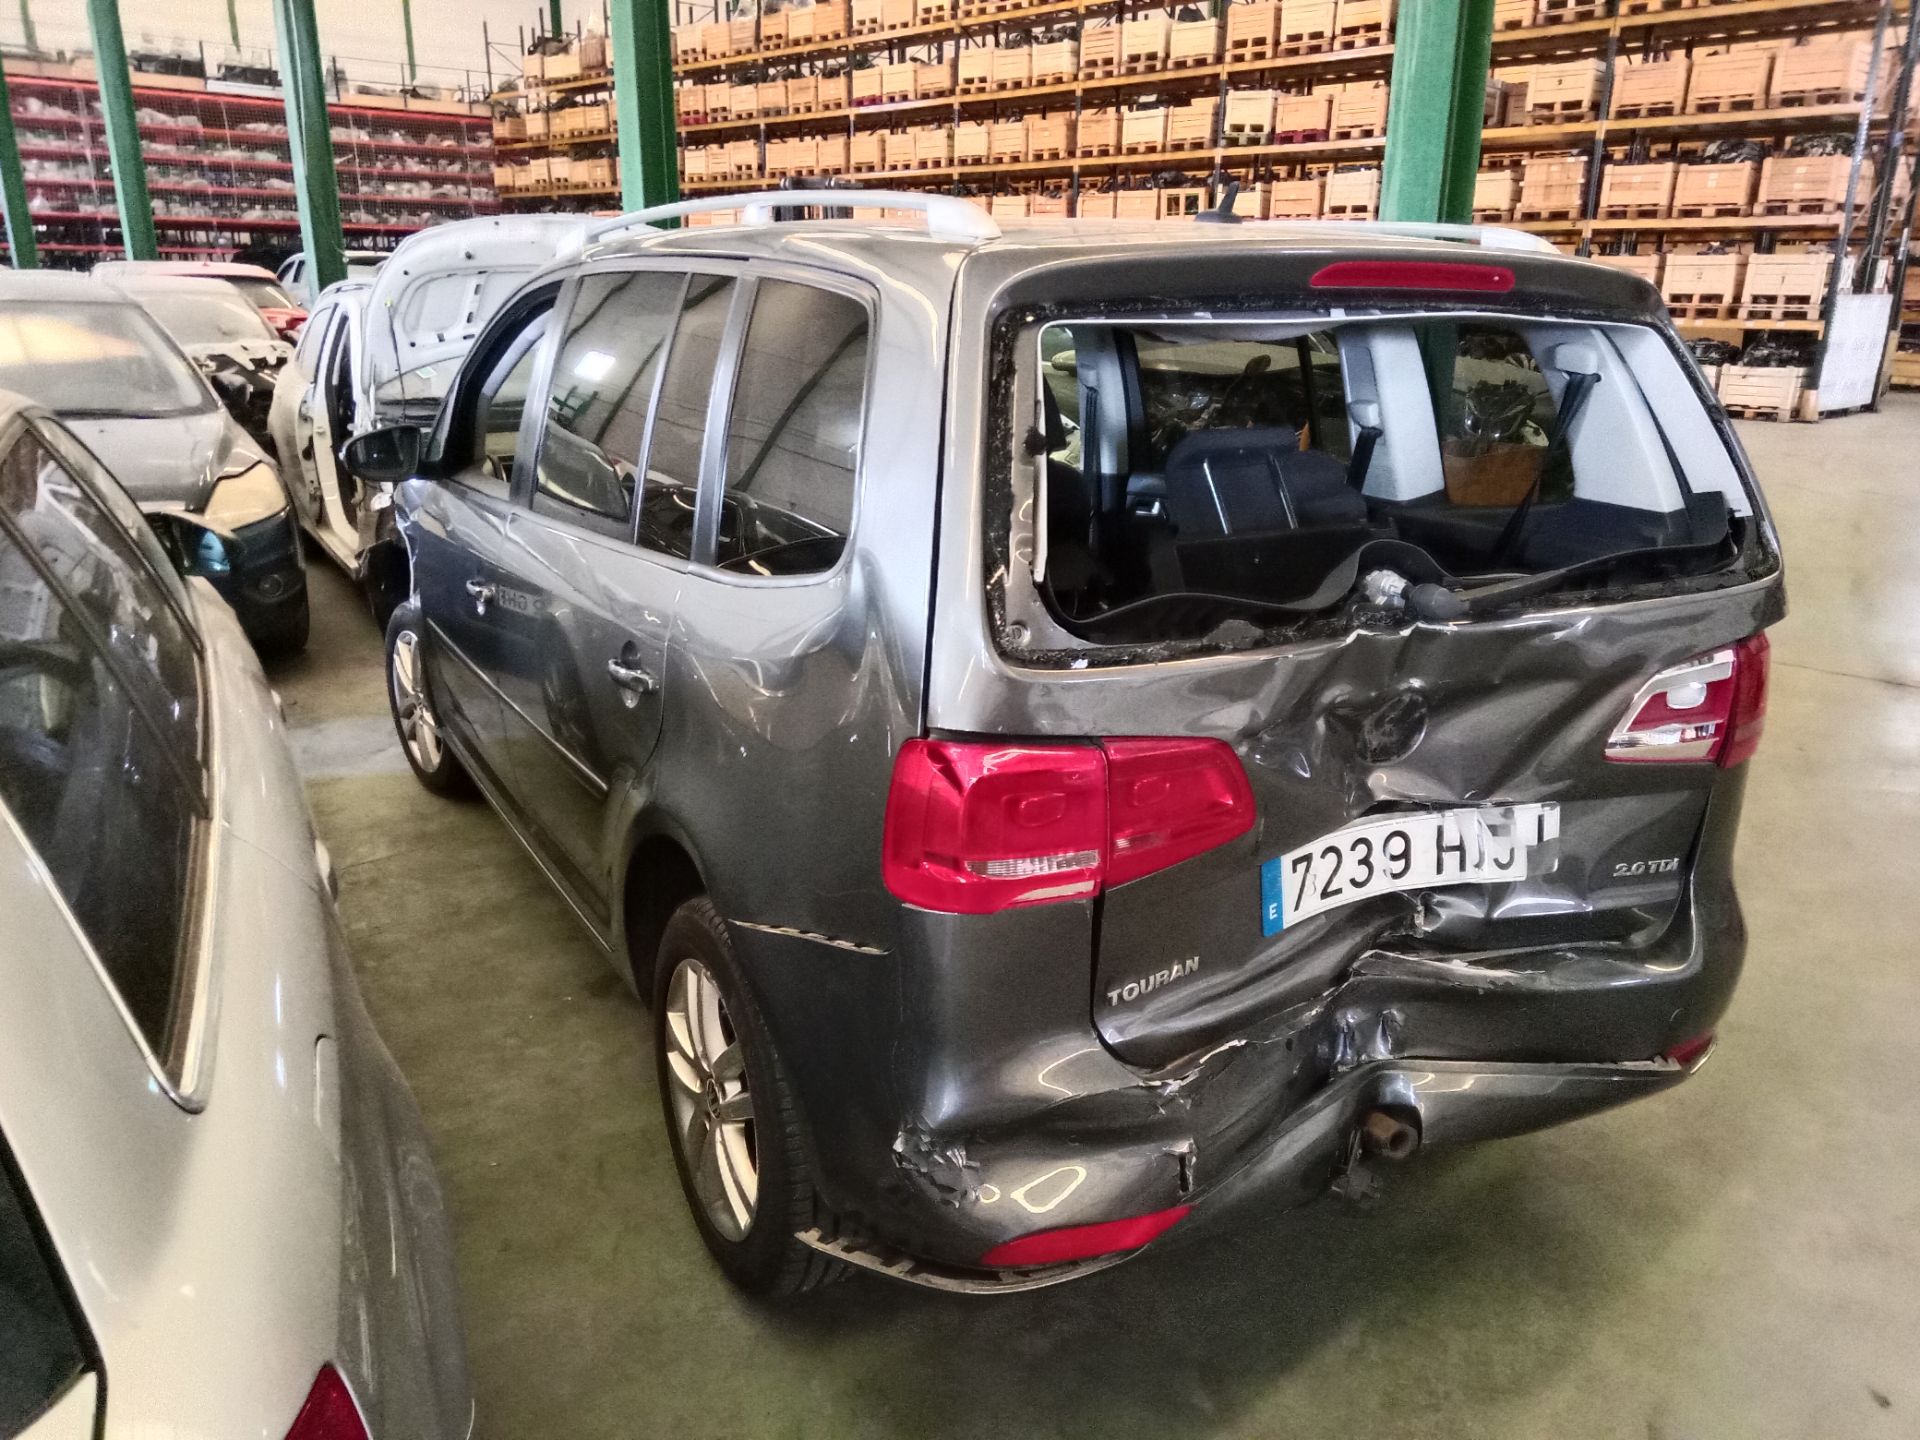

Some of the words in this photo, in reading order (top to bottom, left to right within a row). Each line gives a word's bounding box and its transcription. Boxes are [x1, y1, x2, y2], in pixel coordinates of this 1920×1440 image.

[1292, 829, 1412, 913] 7239
[1648, 857, 1680, 873] TDI
[1268, 902, 1278, 921] E
[1106, 955, 1200, 1007] TOURAN
